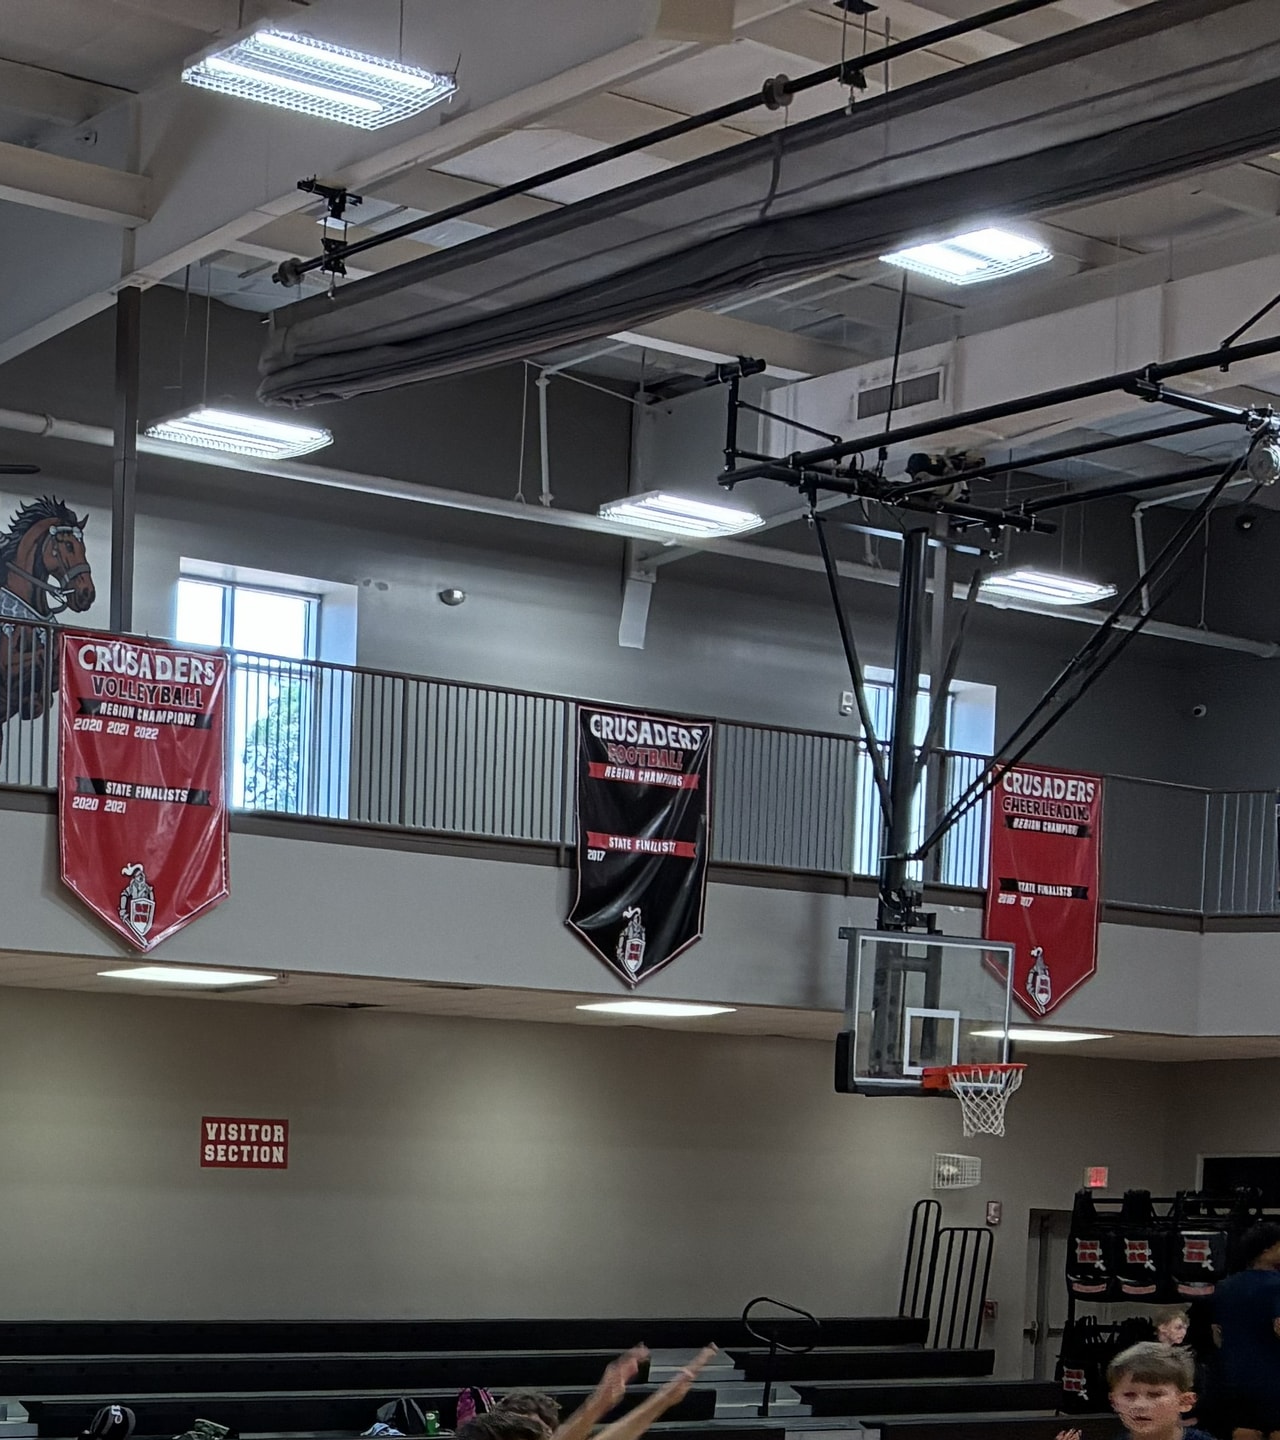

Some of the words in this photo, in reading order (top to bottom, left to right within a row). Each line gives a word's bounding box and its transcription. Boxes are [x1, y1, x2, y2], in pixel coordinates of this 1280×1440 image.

[77, 643, 215, 686] CRUSADERS
[91, 674, 204, 709] VOLLEYBALL
[99, 701, 135, 720] REGION
[136, 706, 197, 727] CHAMPIONS
[73, 717, 103, 733] 2020
[106, 720, 130, 736] 2021
[133, 725, 160, 741] 2022
[589, 714, 703, 750] CRUSADERS
[607, 743, 684, 771] FOOTBALL
[604, 765, 635, 781] REGION
[105, 781, 132, 798] STATE
[135, 785, 189, 803] FINALISTS
[1002, 771, 1095, 803] CRUSADERS
[72, 796, 99, 811] 2020
[104, 799, 127, 814] 2021
[608, 836, 632, 850] STATE
[205, 1122, 285, 1143] VISITOR
[204, 1144, 284, 1163] SECTION
